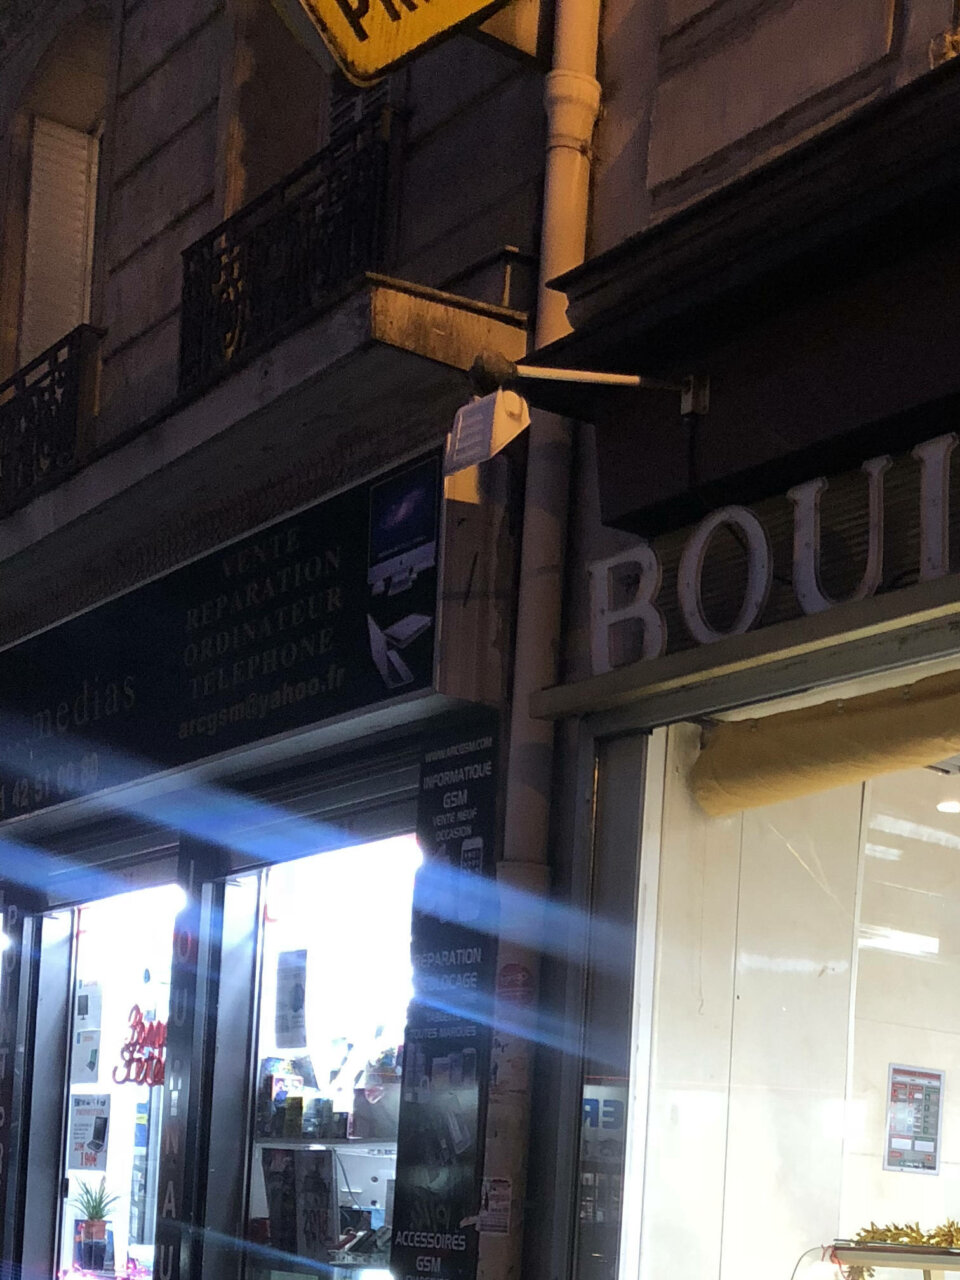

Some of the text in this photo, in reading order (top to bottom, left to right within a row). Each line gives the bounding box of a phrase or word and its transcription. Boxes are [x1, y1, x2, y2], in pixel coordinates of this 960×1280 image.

[186, 546, 341, 631] REPARATION
[183, 587, 342, 667] ORDINATEUR
[189, 628, 333, 699] TELEPHONE
[423, 760, 493, 790] INFORMATIQUE
[443, 789, 468, 808] GSM
[432, 812, 456, 827] VENTE
[436, 825, 472, 842] OCCASION
[395, 1231, 466, 1251] ACCESSOIRES
[416, 1256, 441, 1272] GSM
